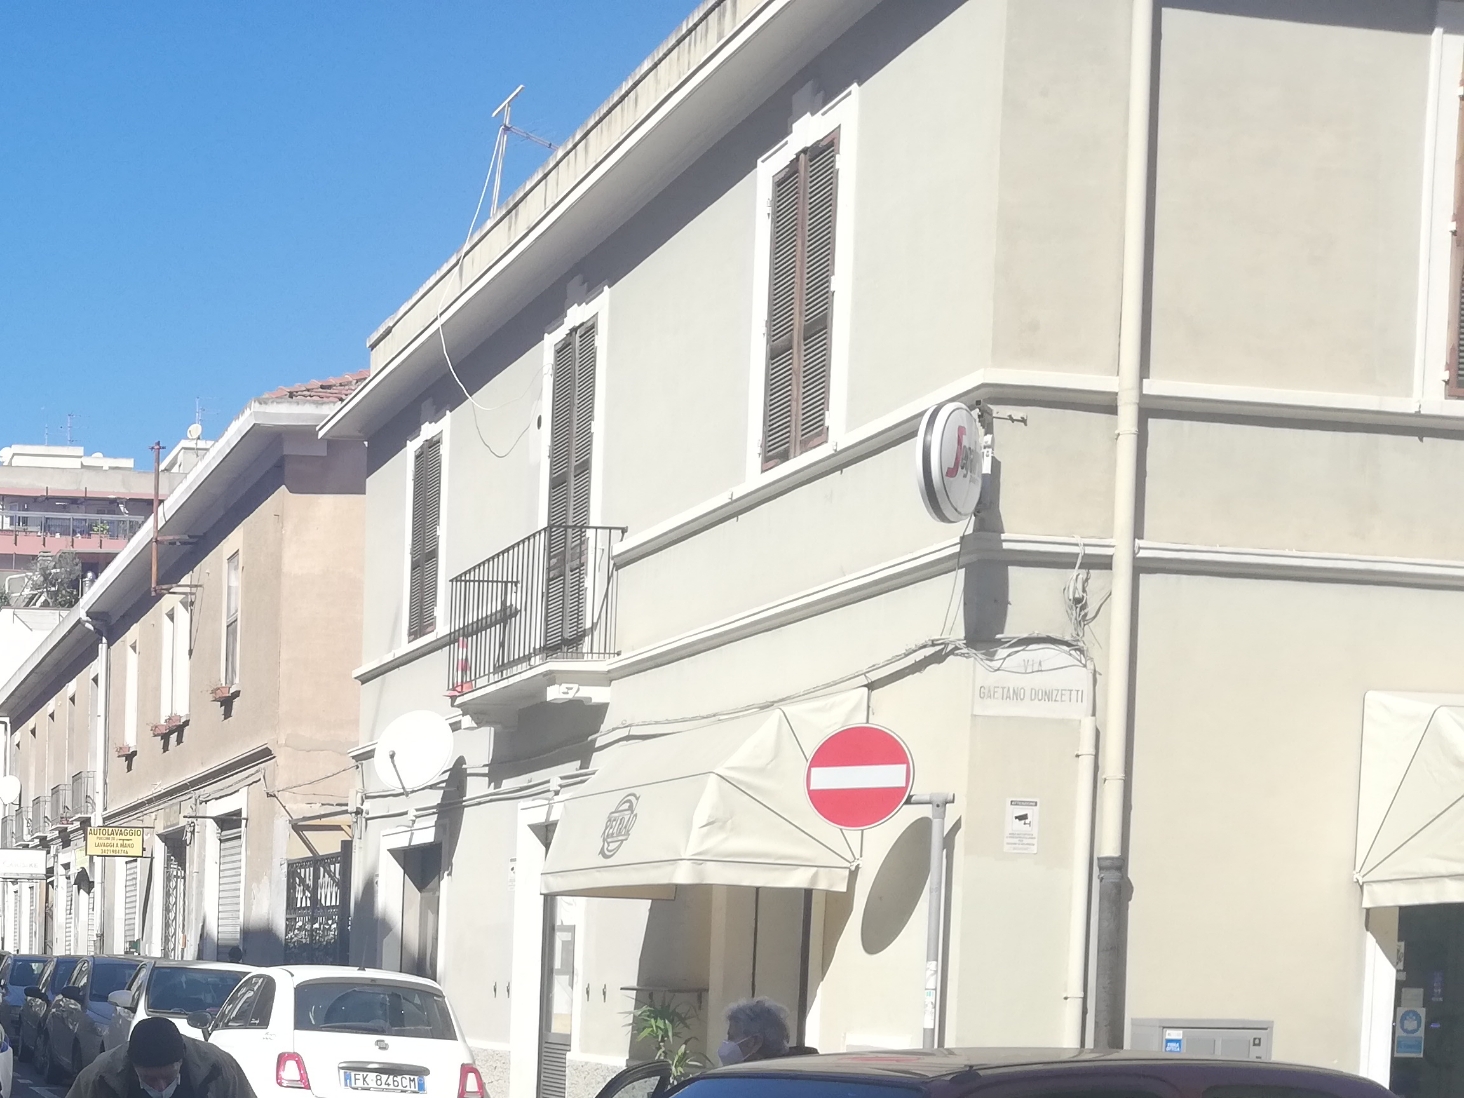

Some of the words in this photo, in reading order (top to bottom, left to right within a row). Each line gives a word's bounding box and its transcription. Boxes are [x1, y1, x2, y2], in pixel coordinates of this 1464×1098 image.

[1023, 659, 1043, 673] VIA
[979, 685, 1026, 701] GAETANO
[1030, 687, 1084, 703] DONIZETTI
[88, 828, 142, 837] AUTOLAVAGGIO
[353, 1073, 370, 1086] FK
[375, 1074, 417, 1089] 846CM
